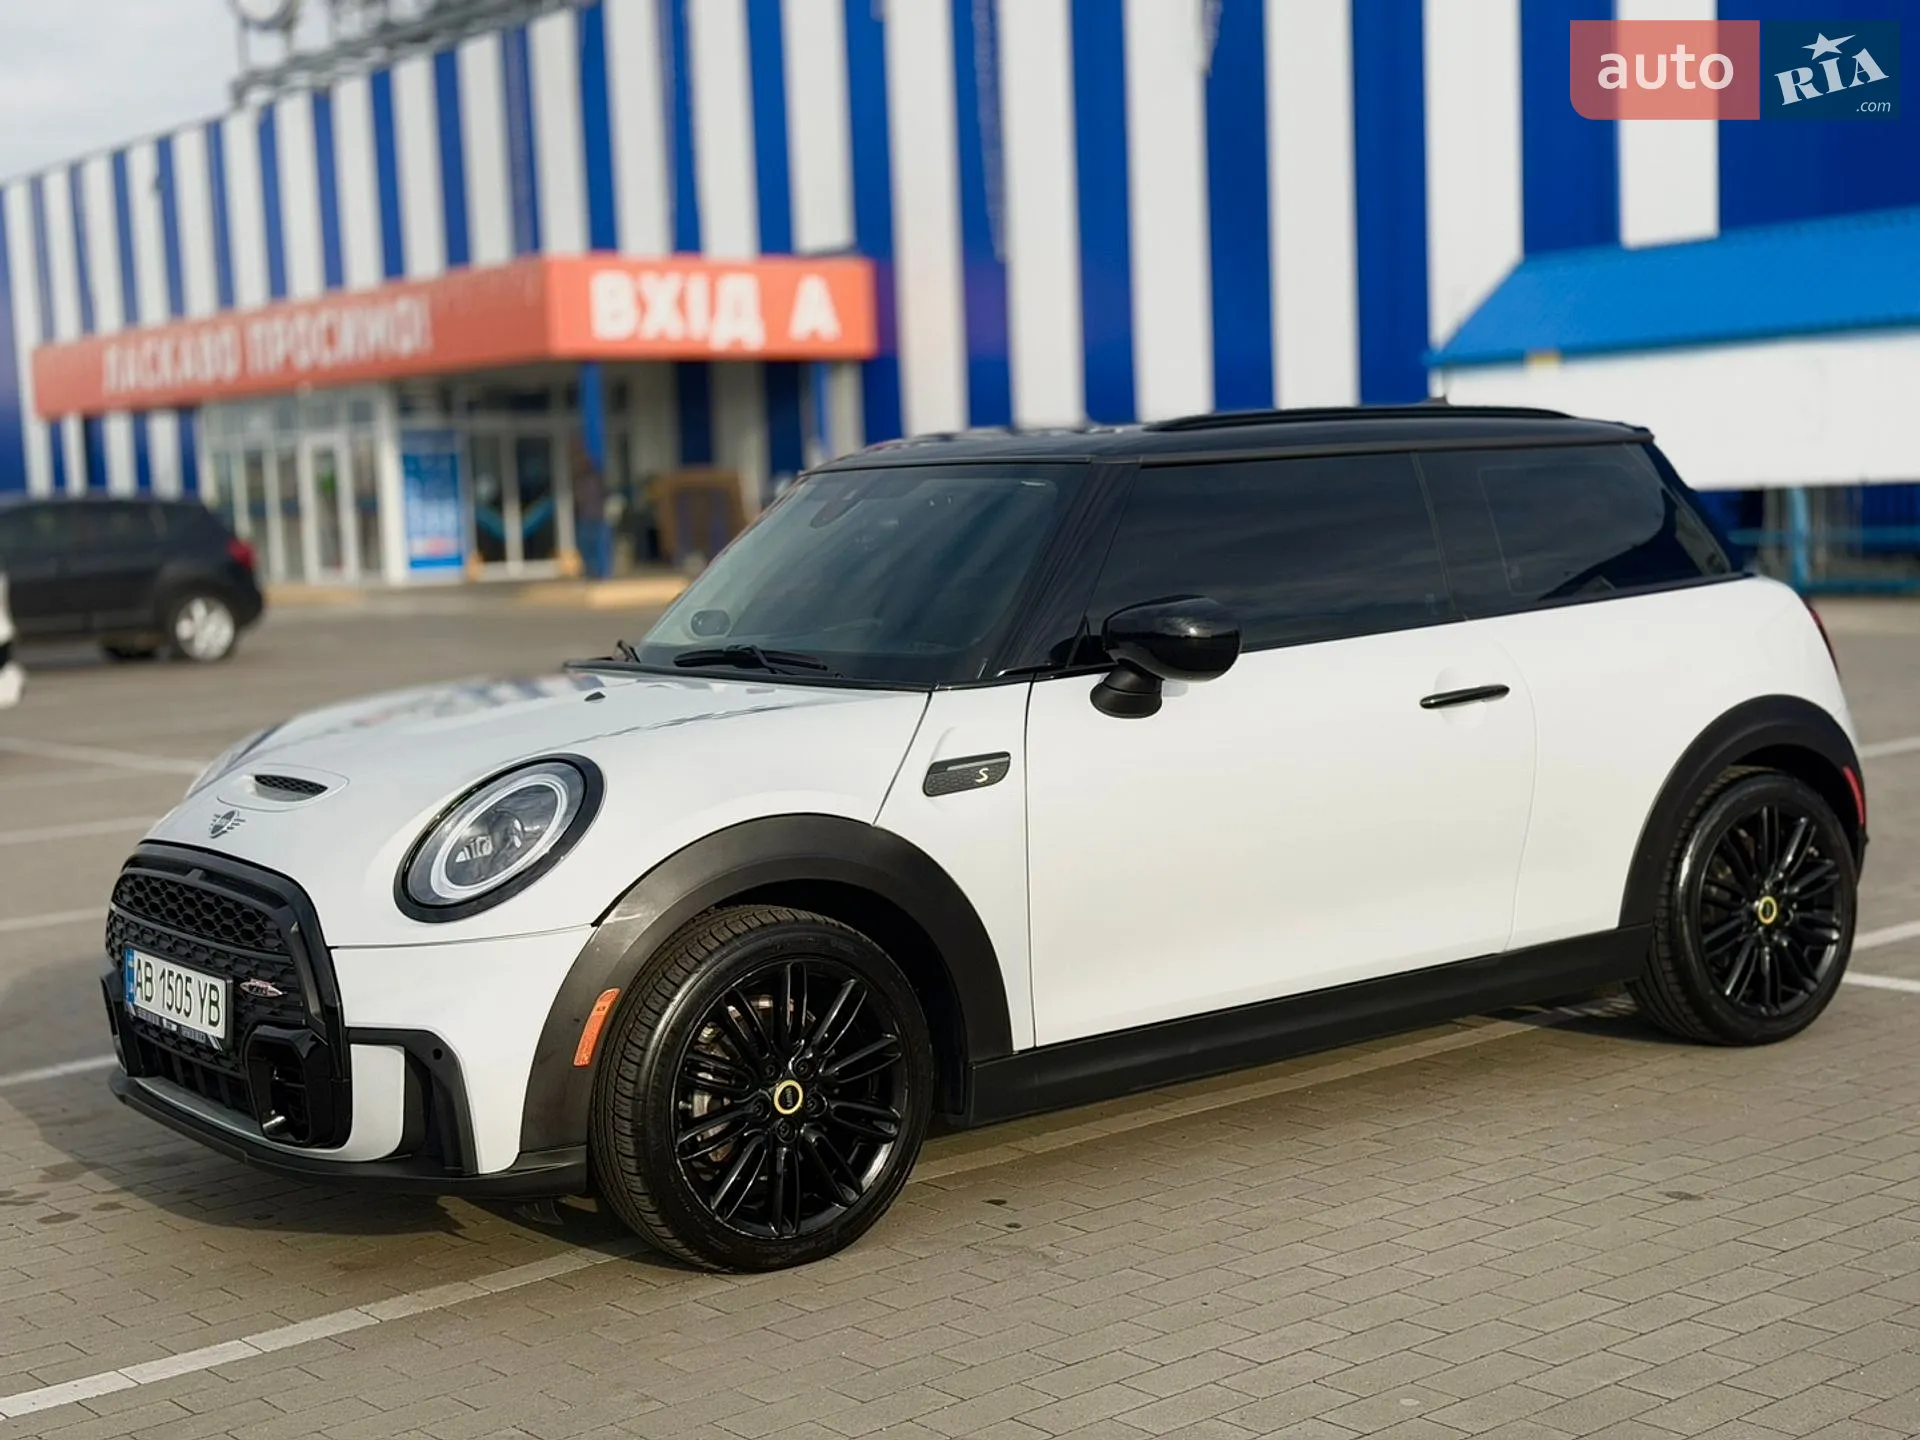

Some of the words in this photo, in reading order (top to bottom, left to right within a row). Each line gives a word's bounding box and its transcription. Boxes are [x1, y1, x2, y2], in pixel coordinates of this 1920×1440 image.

[589, 269, 766, 351] ВХІД
[788, 273, 841, 341] А
[975, 767, 989, 783] S
[136, 958, 155, 1003] AB
[159, 967, 192, 1018] 1505
[198, 979, 221, 1028] YB
